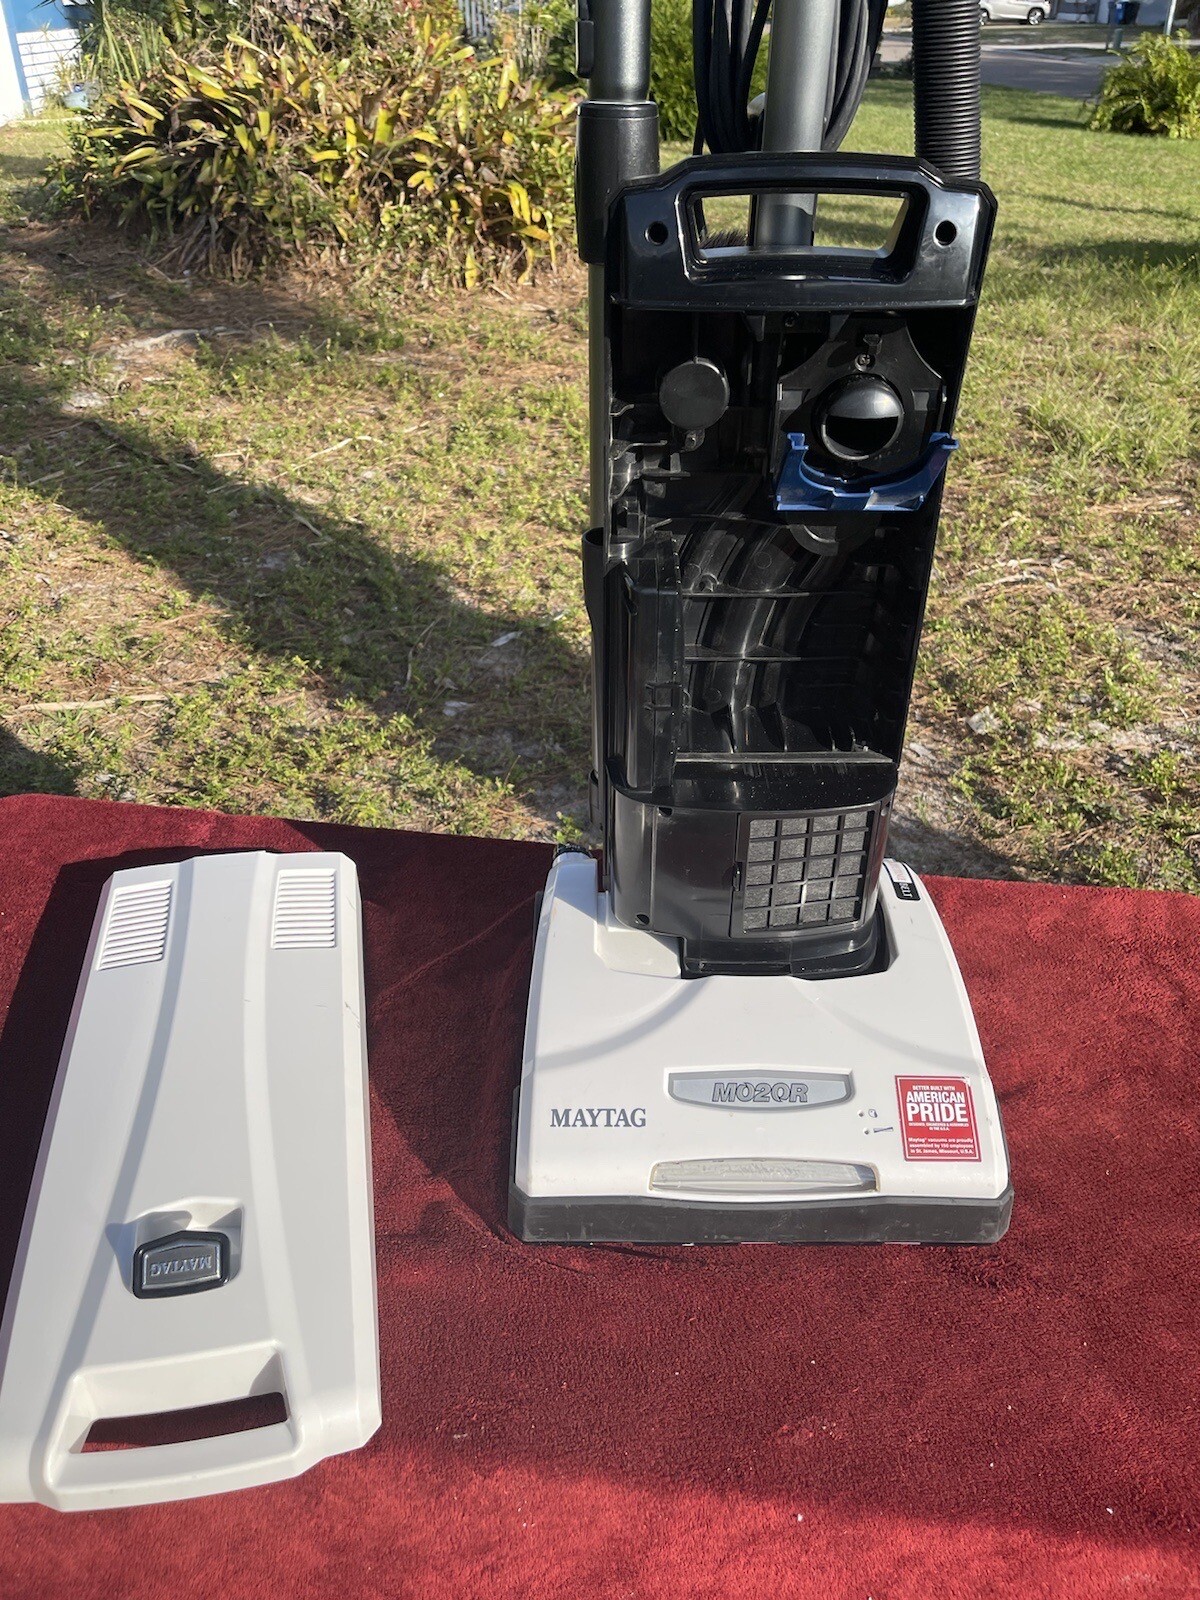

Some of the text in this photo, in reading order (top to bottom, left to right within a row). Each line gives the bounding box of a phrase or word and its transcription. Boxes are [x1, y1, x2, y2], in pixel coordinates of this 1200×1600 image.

[906, 1091, 965, 1103] AMERICAN
[550, 1108, 646, 1128] MAYTAG
[906, 1103, 969, 1122] PRIDE
[150, 1254, 212, 1277] MAYTAG
